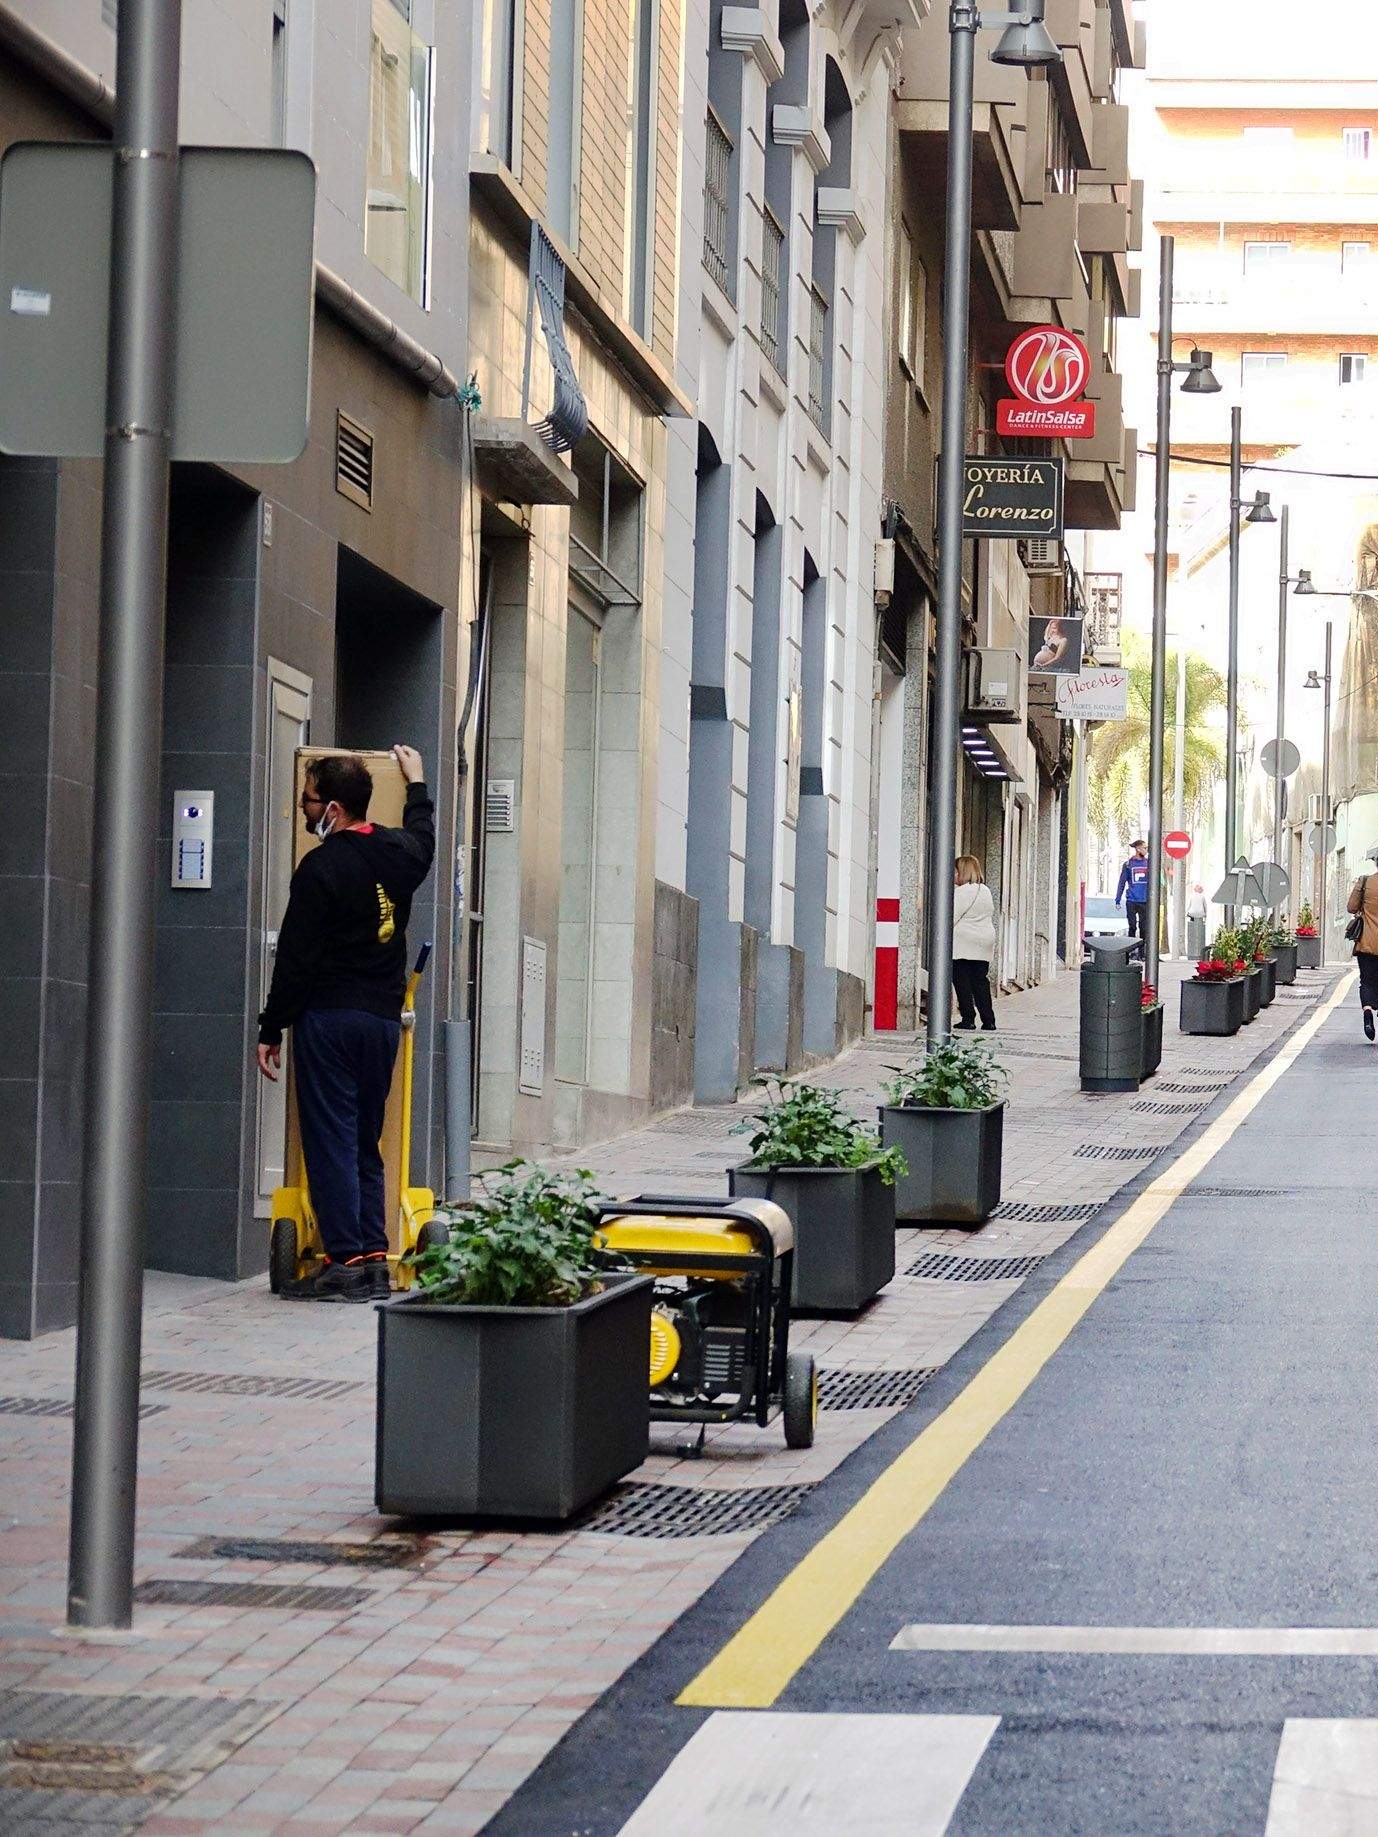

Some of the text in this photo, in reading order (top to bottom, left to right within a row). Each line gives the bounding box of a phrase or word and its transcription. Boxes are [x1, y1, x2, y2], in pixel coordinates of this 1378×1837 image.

[1007, 409, 1086, 425] LatinSalsa
[963, 484, 1053, 519] Lorenzo
[1058, 672, 1124, 704] Floresta
